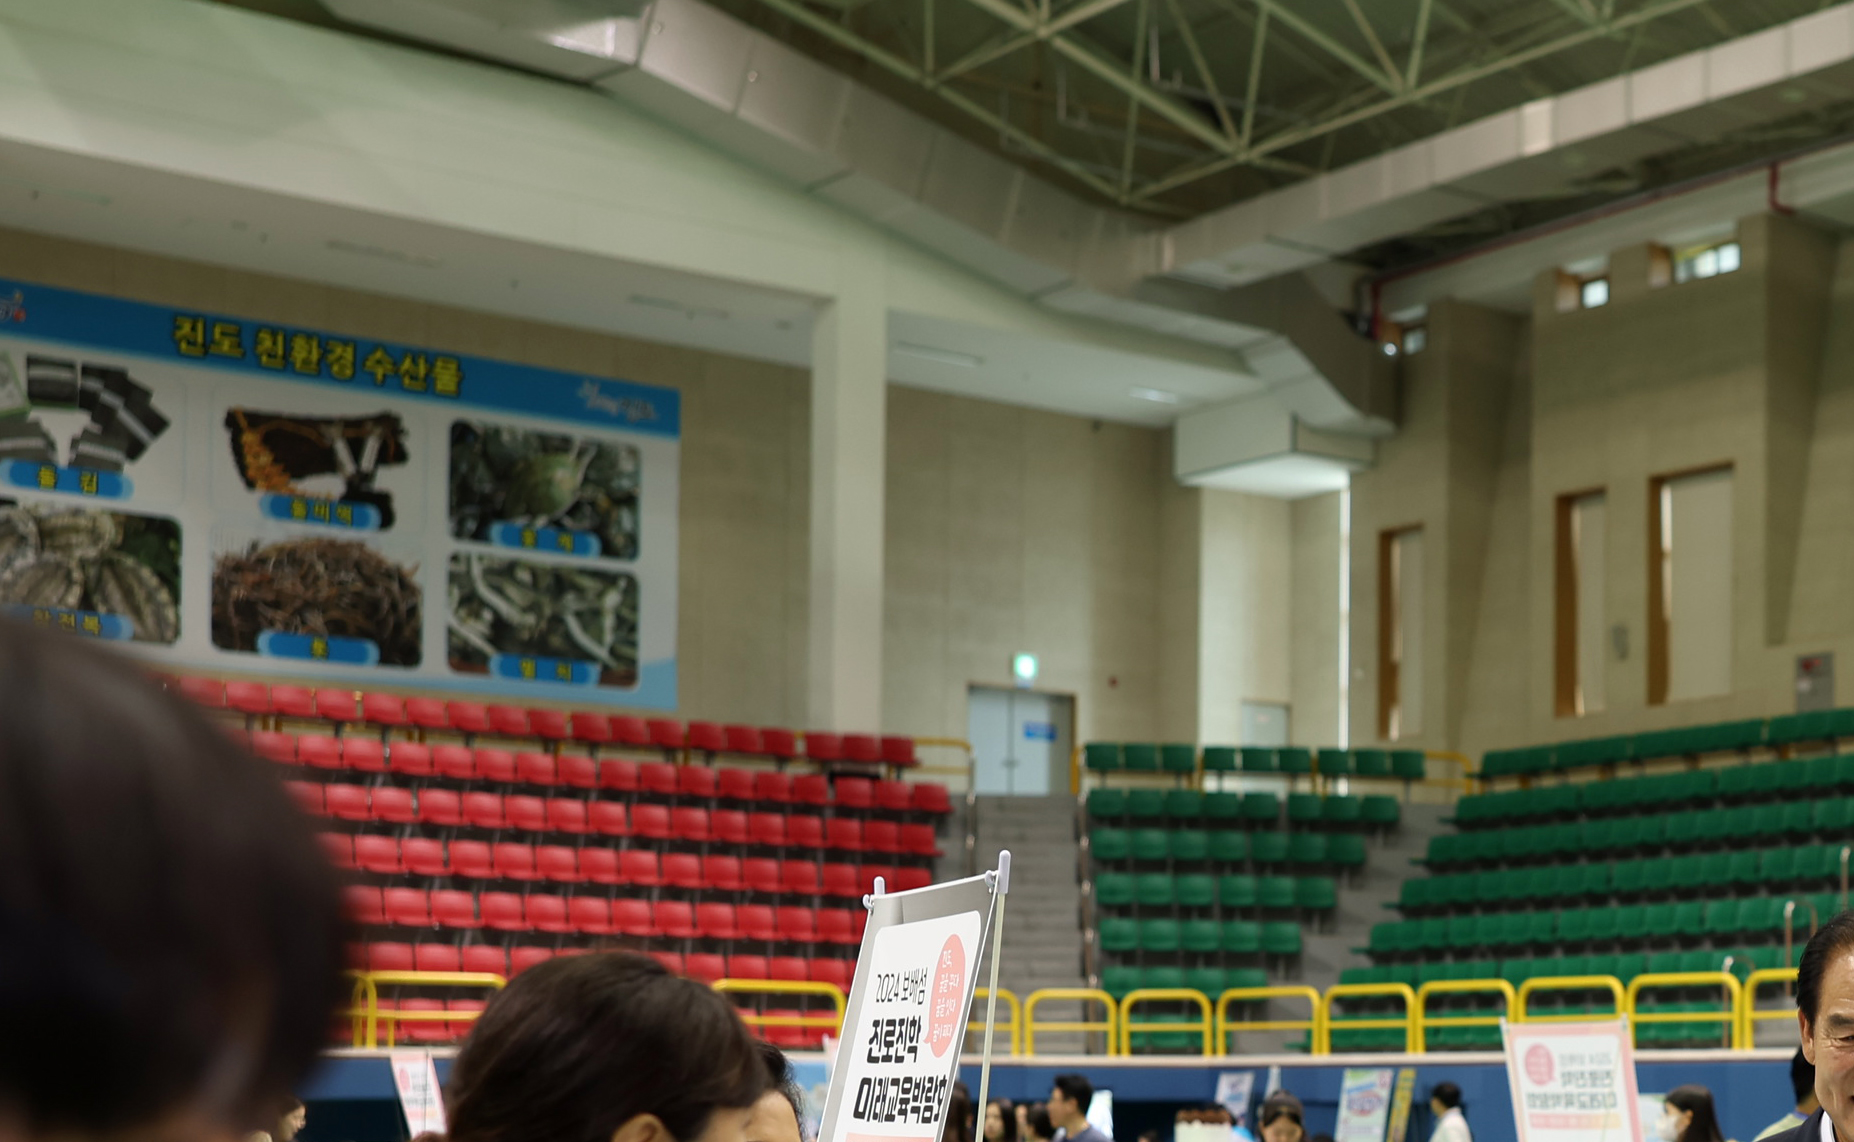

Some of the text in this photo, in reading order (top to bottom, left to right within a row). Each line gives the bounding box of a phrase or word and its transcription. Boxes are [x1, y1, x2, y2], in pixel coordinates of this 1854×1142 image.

[172, 315, 464, 396] 진도 친환경 수산물
[876, 967, 928, 1005] 2024 보배섬
[867, 1015, 922, 1064] 진로진학
